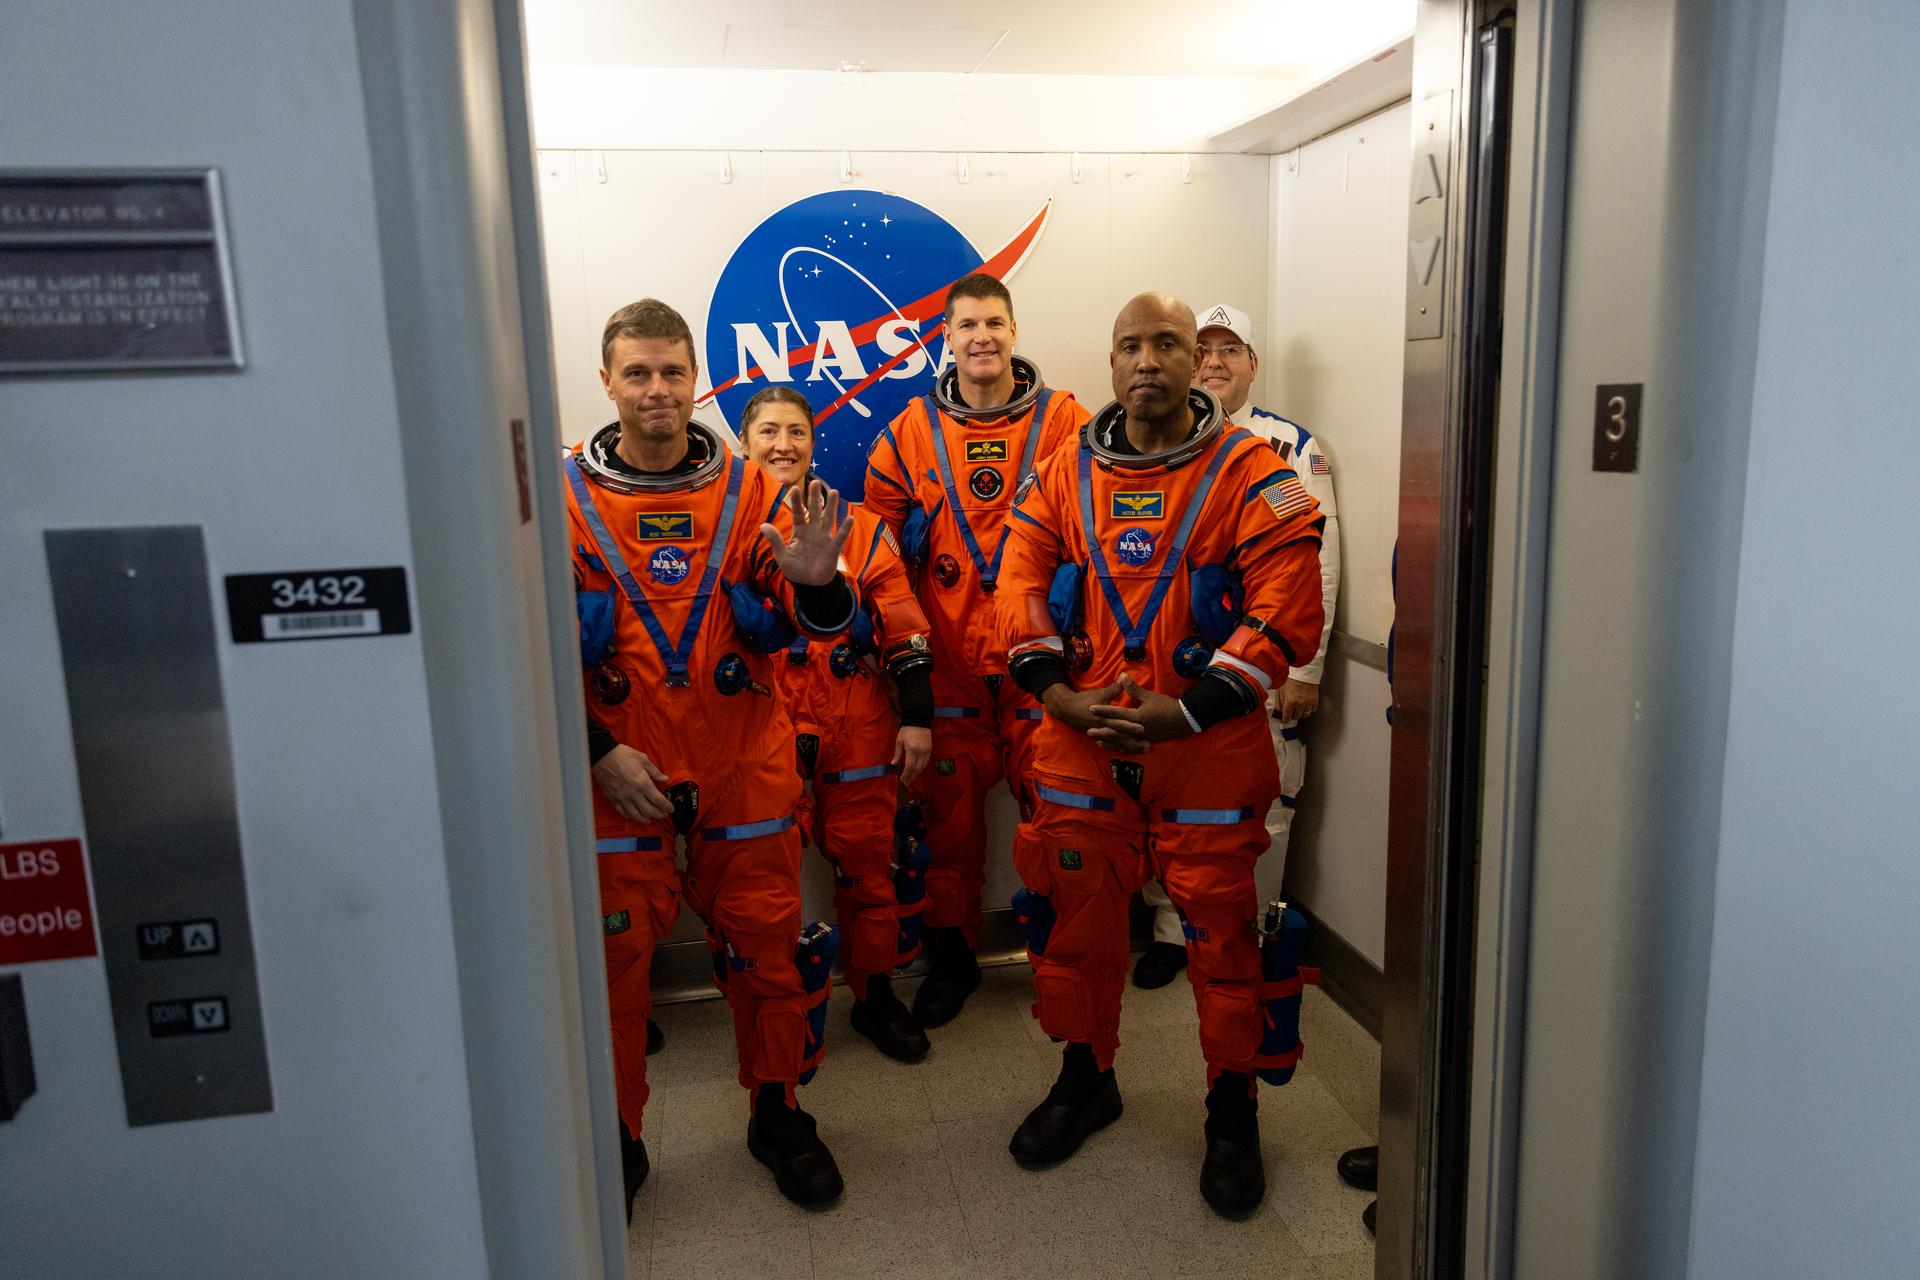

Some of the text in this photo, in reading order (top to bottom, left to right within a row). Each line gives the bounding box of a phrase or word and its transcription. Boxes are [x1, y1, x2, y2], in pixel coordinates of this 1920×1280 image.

[1605, 395, 1627, 442] 3
[1120, 541, 1152, 552] NASA
[652, 559, 688, 570] NASA
[271, 575, 367, 608] 3432
[0, 848, 61, 880] LBS
[0, 906, 83, 938] eople
[144, 925, 173, 945] UP
[152, 1004, 188, 1024] DOWN
